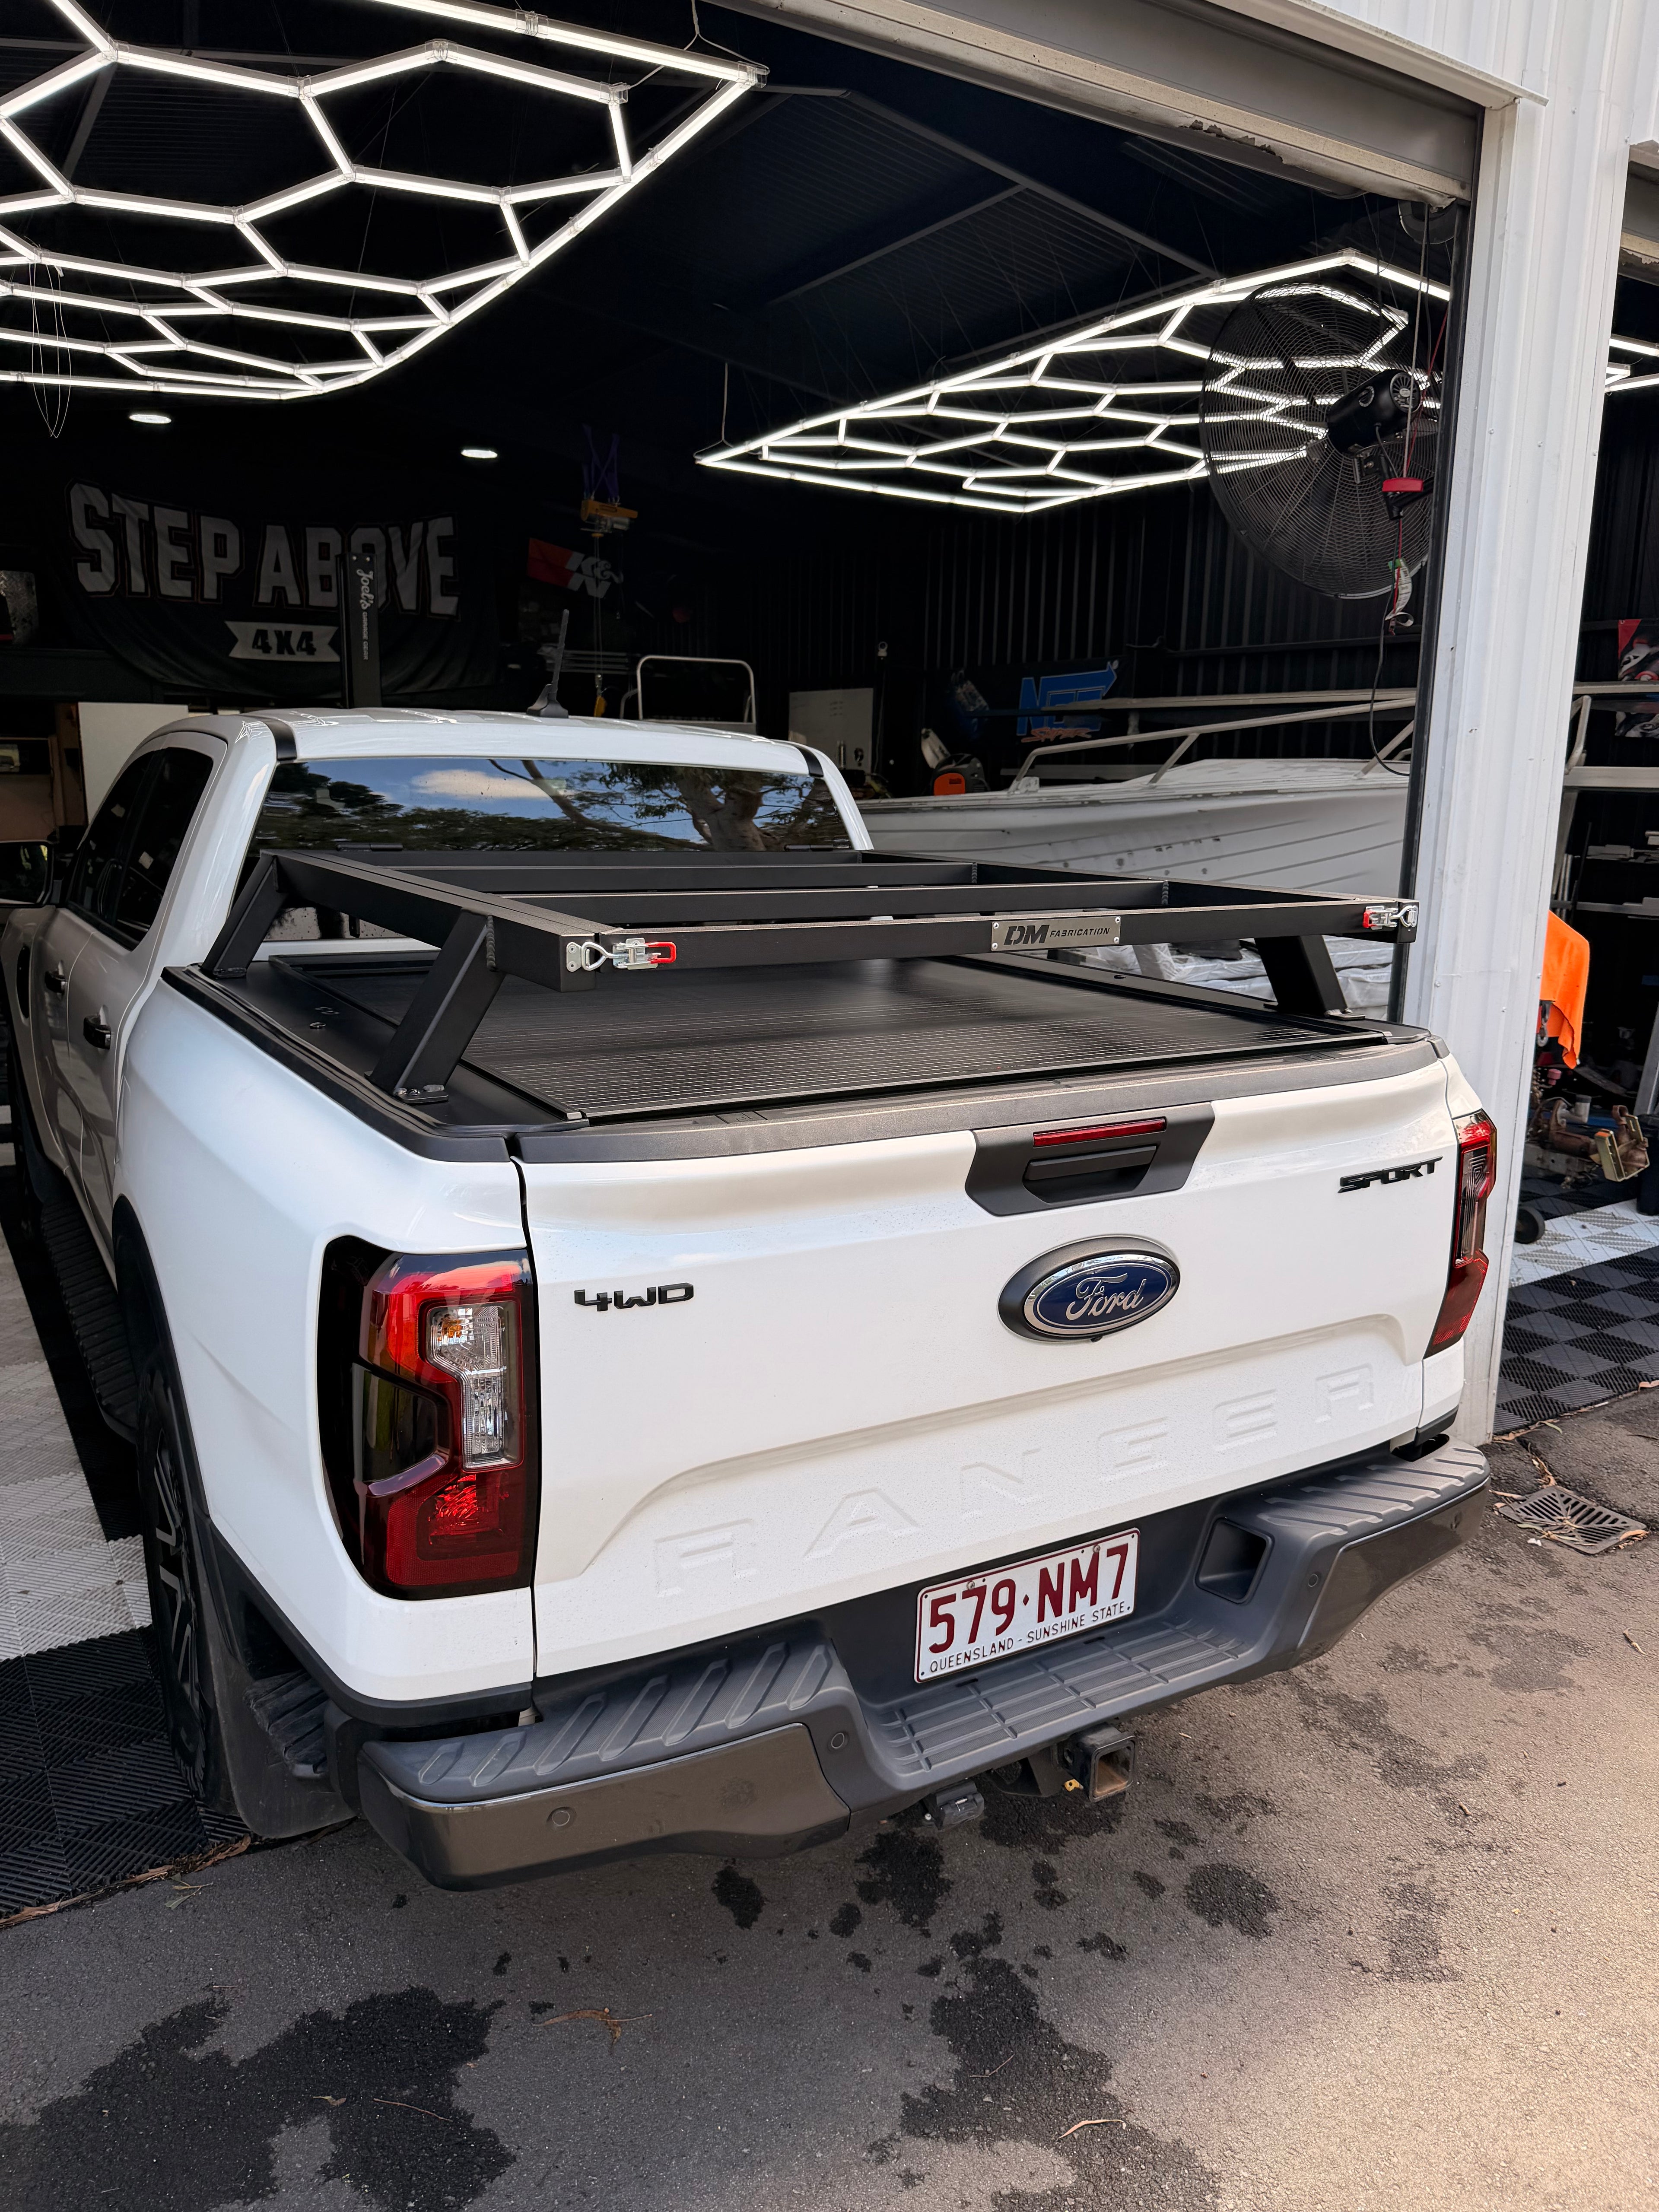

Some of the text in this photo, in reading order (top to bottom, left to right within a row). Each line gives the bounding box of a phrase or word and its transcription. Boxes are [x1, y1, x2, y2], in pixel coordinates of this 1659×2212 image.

[67, 480, 243, 603] STEP
[356, 569, 375, 610] Joel's
[252, 629, 317, 656] 4X4
[1004, 925, 1111, 945] DM FABRICATION
[1337, 1155, 1443, 1194] SPORT
[574, 1282, 694, 1312] 4WD
[1065, 1273, 1147, 1321] Ford
[653, 1361, 1375, 1599] RANGER
[930, 1637, 1014, 1672] QUEENSLAND
[1027, 1614, 1085, 1643] SUNSHINE
[1092, 1601, 1125, 1622] STATE
